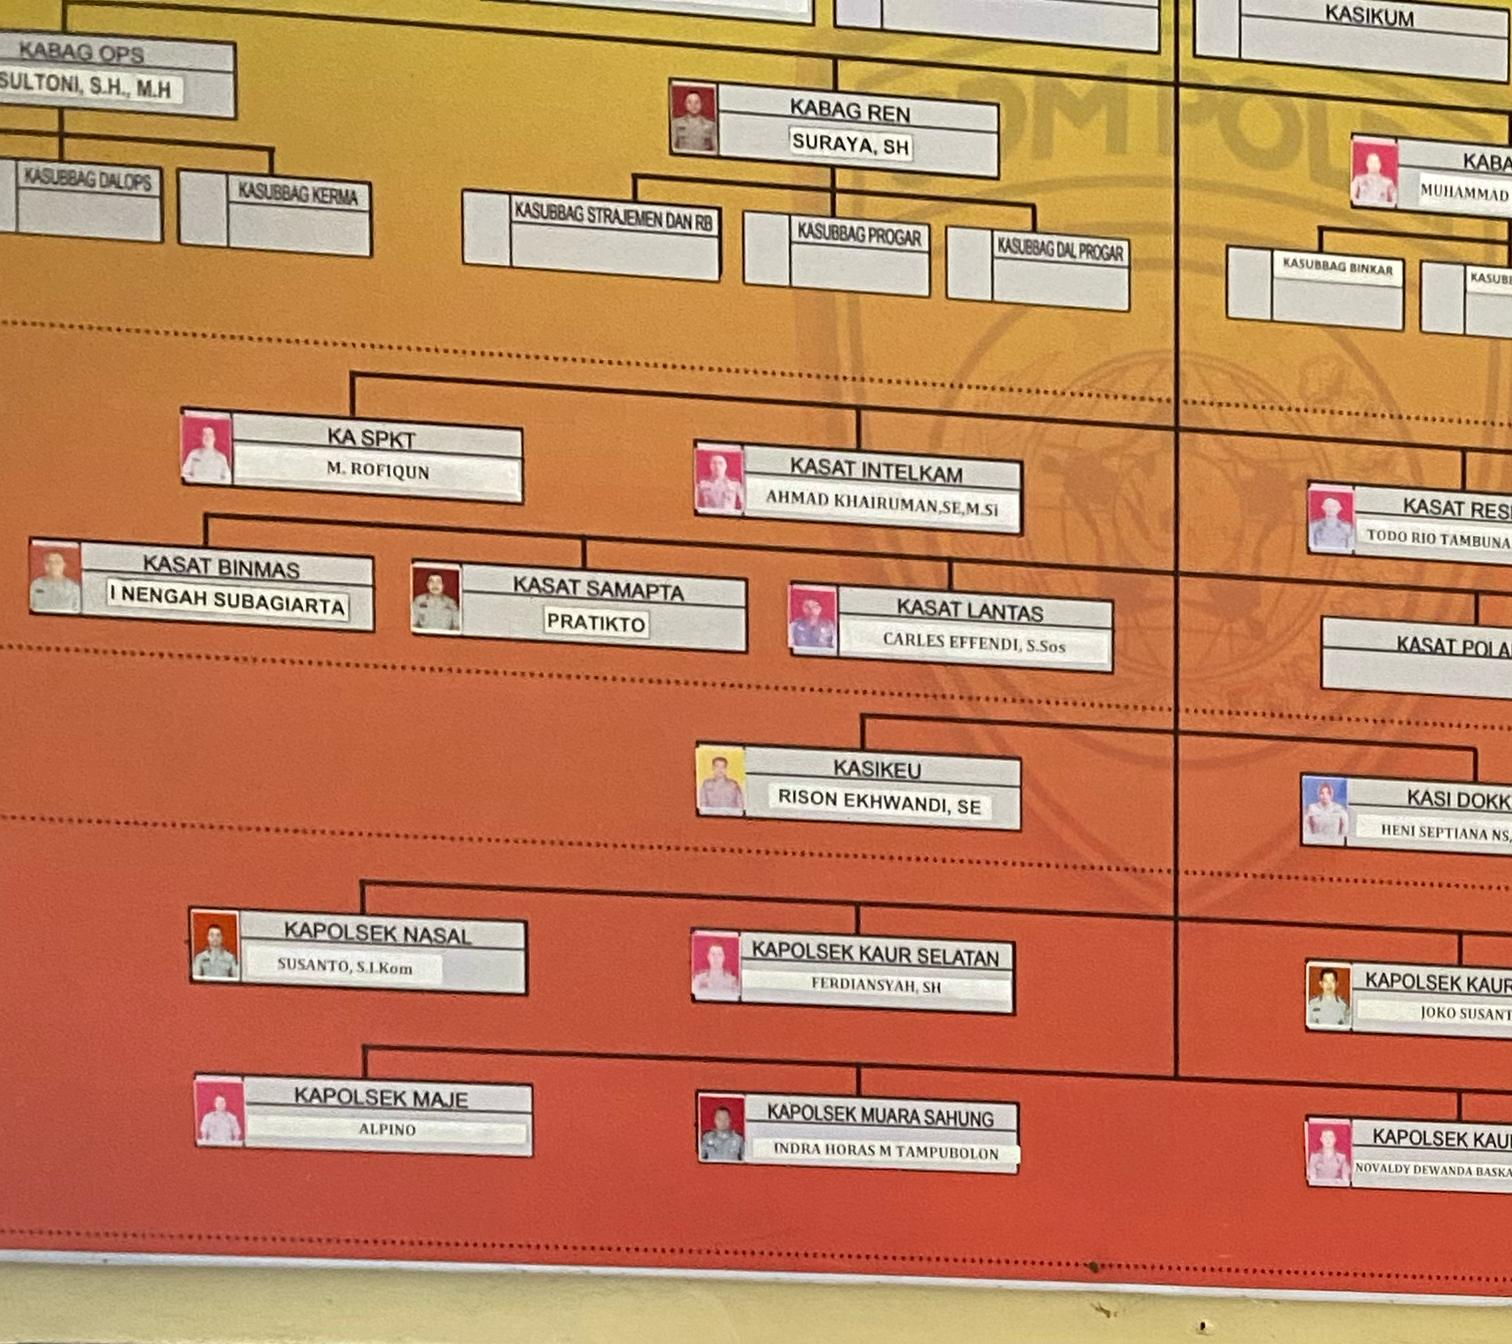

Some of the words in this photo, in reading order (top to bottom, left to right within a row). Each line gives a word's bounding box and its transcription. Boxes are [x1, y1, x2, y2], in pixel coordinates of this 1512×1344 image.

[1326, 4, 1415, 27] KASIKUM
[19, 41, 95, 62] KABAG
[100, 45, 145, 64] OPS
[136, 80, 172, 99] M.H
[791, 98, 862, 120] KABAG
[868, 103, 911, 124] REN
[792, 132, 878, 156] SURAYA,
[882, 138, 909, 156] SH
[328, 427, 356, 446] KA
[361, 430, 416, 449] SPKT
[791, 456, 857, 477] KASAT
[862, 461, 964, 484] INTELKAM
[1404, 498, 1465, 518] KASAT
[144, 554, 212, 574] KASAT
[218, 558, 300, 579] BINMAS
[514, 575, 581, 596] KASAT
[586, 580, 684, 602] SAMAPTA
[122, 586, 207, 607] NENGAH
[214, 590, 345, 615] SUBAGIARTA
[898, 598, 962, 618] KASAT
[968, 602, 1044, 623] LANTAS
[548, 612, 646, 634] PRATIKTO
[834, 759, 922, 780] KASIKEU
[778, 789, 838, 807] RISON
[844, 792, 952, 816] EKHWANDI,
[958, 798, 982, 815] SE
[752, 942, 854, 963] KAPOLSEK
[859, 945, 912, 964] KAUR
[918, 947, 1000, 967] SELATAN
[1366, 972, 1462, 991] KAPOLSEK
[294, 1088, 406, 1108] KAPOLSEK
[412, 1090, 468, 1108] MAJE
[359, 1122, 417, 1136] ALPINO
